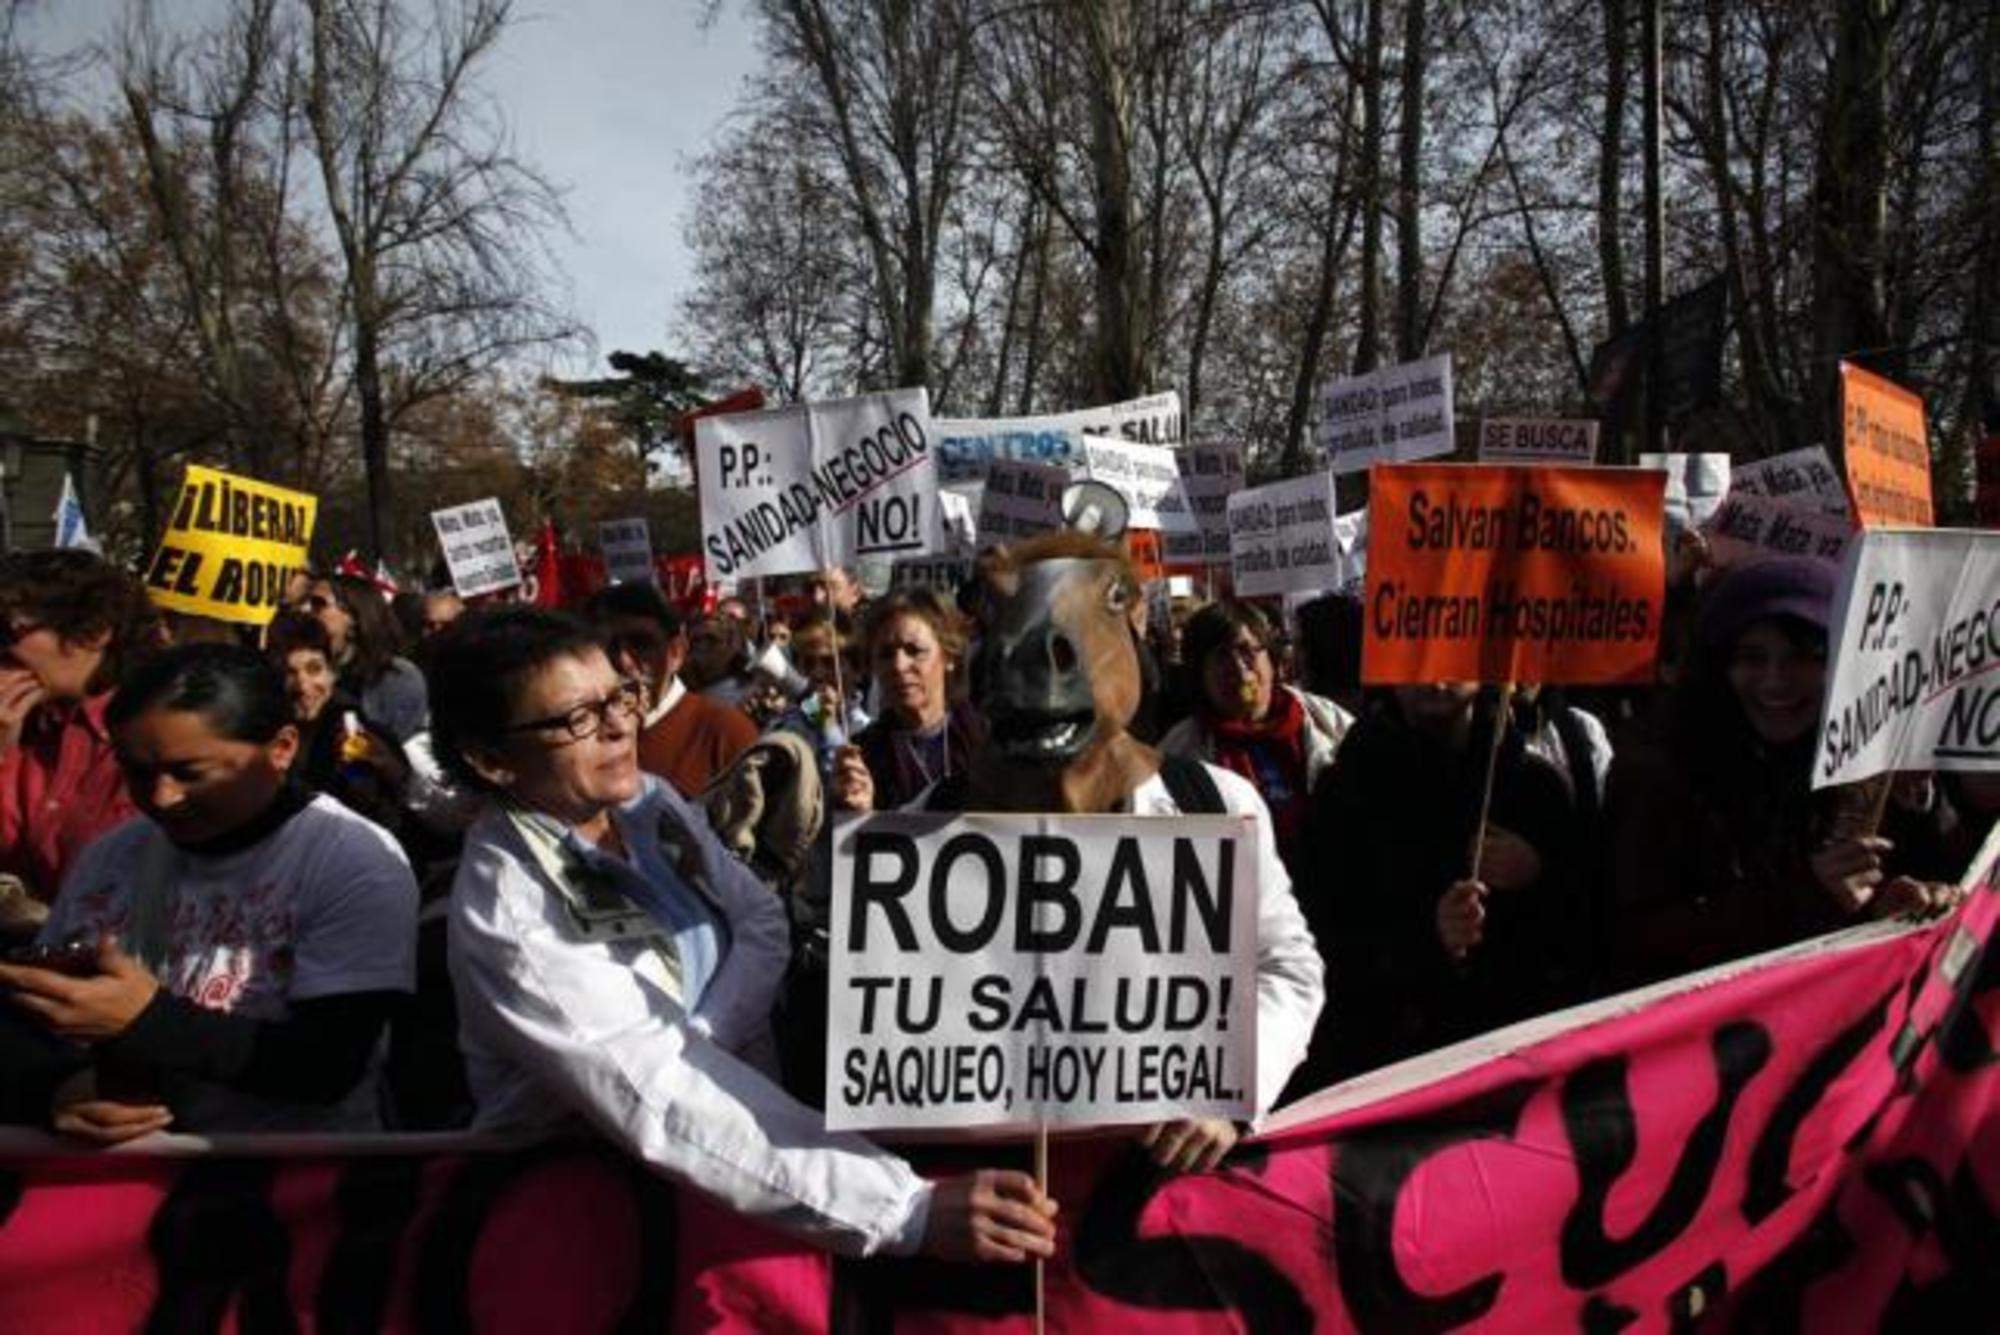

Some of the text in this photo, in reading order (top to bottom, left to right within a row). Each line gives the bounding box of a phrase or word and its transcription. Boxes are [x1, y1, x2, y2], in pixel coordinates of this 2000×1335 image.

[1485, 423, 1588, 449] SE BUSCA
[857, 493, 921, 546] NO!
[1407, 489, 1637, 552] Salvan Bancos.
[150, 547, 203, 596] EL
[1374, 580, 1480, 640] Cierran
[847, 832, 1236, 954] ROBAN
[850, 974, 1233, 1034] TU SALUD!
[843, 1045, 1244, 1111] SAQUEO, HOY LEGAL.
